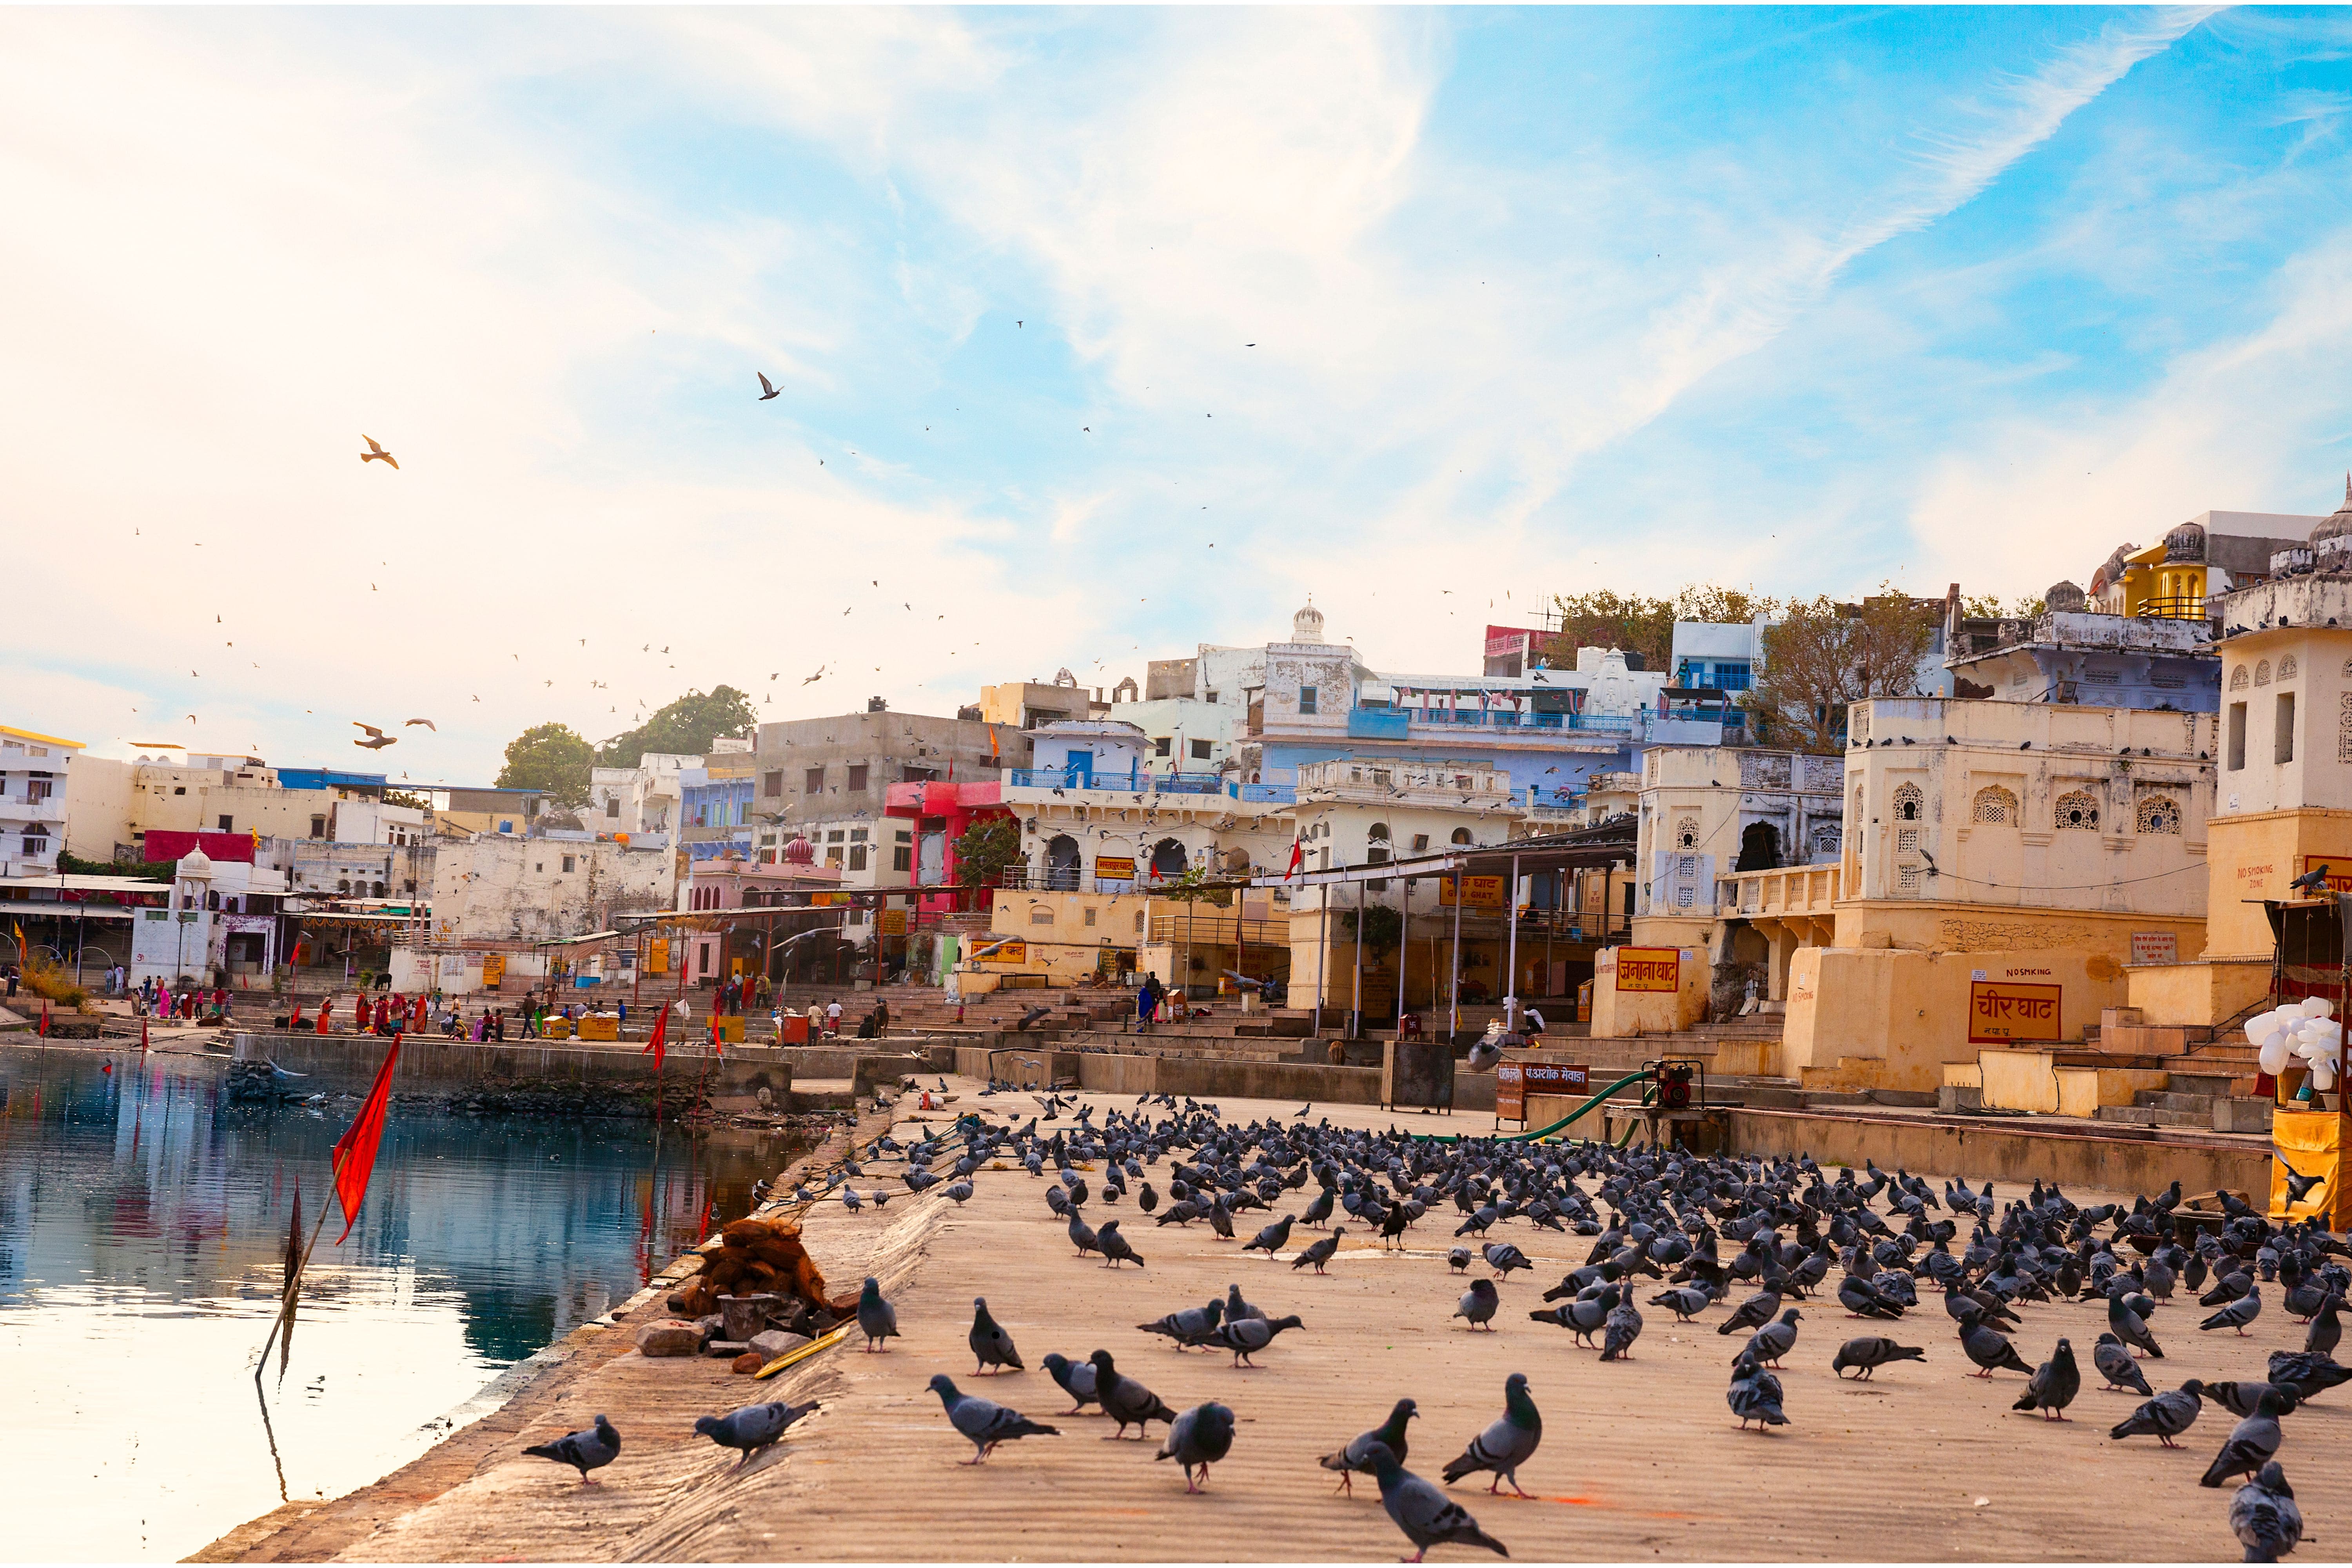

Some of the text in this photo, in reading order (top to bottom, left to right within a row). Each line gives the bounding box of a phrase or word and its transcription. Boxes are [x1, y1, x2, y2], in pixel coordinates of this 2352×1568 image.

[2238, 864, 2273, 879] NO SMOKING
[1473, 878, 1498, 888] घाट
[2250, 879, 2263, 888] ZONE
[1471, 891, 1494, 899] GHAT
[1620, 960, 1675, 981] जनाना घाट
[1976, 989, 2056, 1020] चीर घाट
